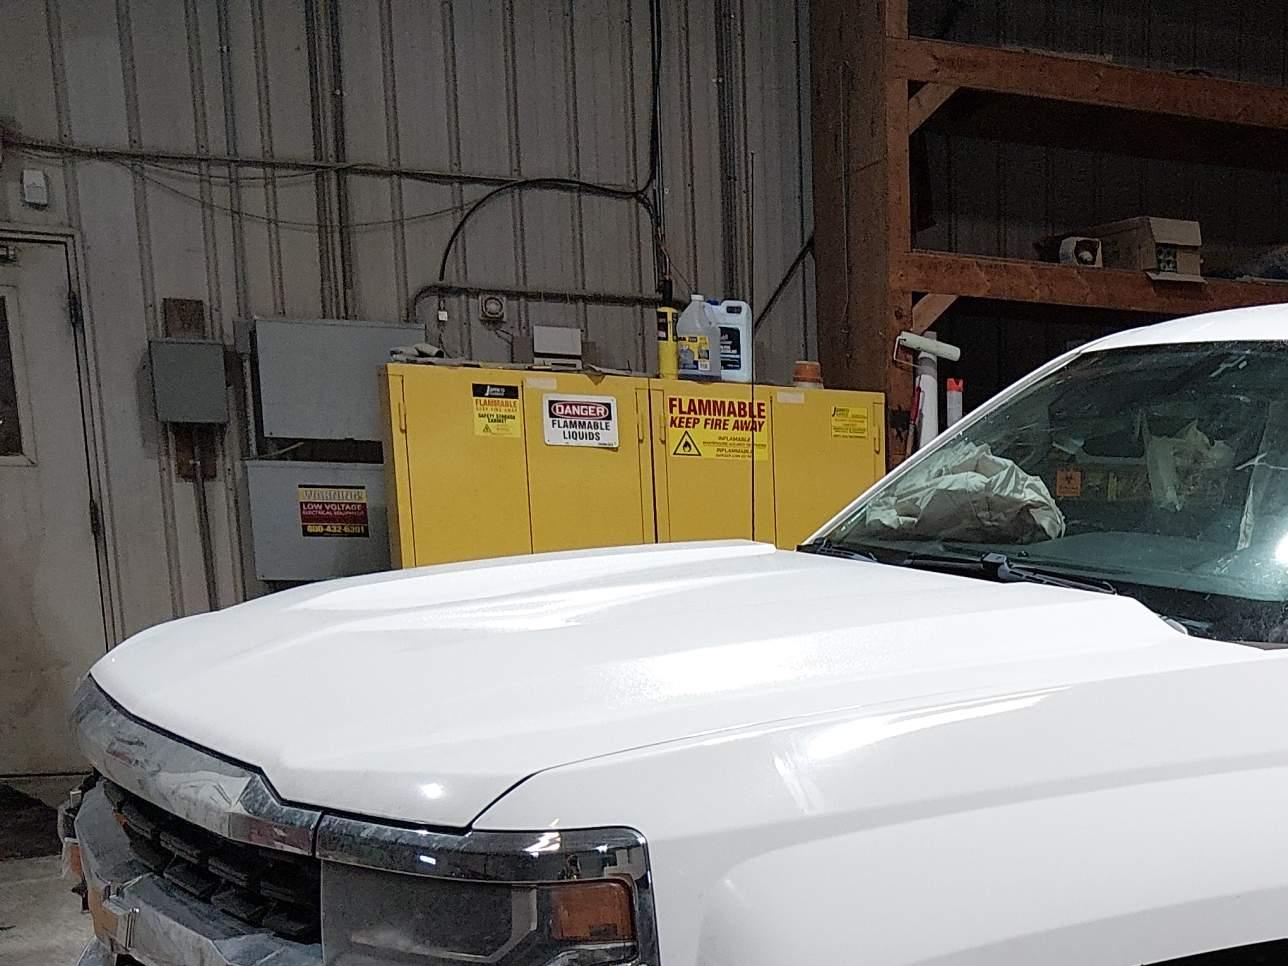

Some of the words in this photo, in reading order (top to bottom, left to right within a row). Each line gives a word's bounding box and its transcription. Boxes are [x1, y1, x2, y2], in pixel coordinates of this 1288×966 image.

[555, 404, 605, 417] DANGER
[668, 397, 766, 419] FLAMMABLE
[551, 419, 611, 431] FLAMMABLE
[669, 416, 700, 429] KEEP
[703, 418, 730, 431] FIRE
[731, 419, 765, 432] AWAY
[562, 430, 601, 441] LIQUIDS
